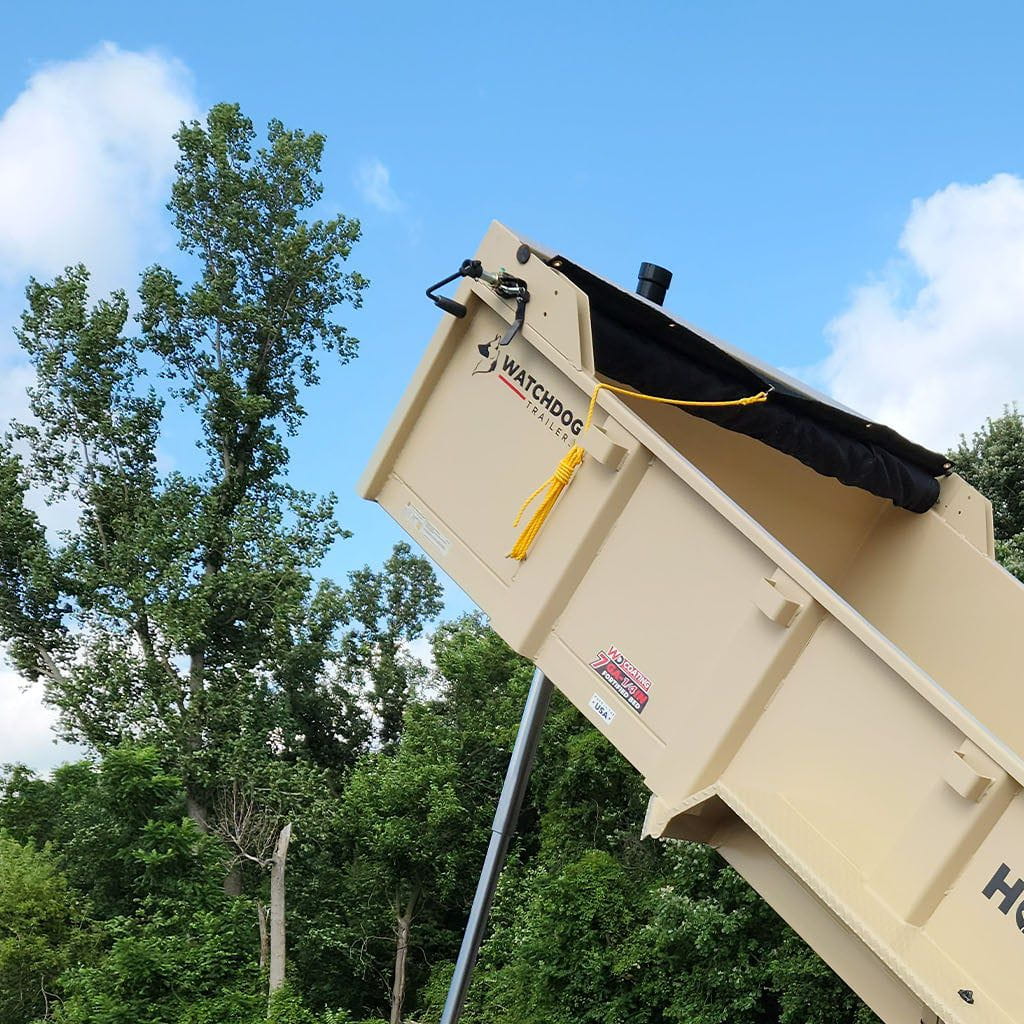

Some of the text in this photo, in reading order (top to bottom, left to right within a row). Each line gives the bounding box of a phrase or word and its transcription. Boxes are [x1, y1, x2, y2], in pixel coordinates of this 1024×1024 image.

[502, 355, 584, 436] WATCHDOG
[526, 400, 576, 447] TRAILER
[592, 652, 610, 668] 7
[623, 661, 651, 689] COATING
[601, 670, 629, 698] FORTIFIED
[628, 696, 641, 709] BED
[594, 702, 609, 719] USA
